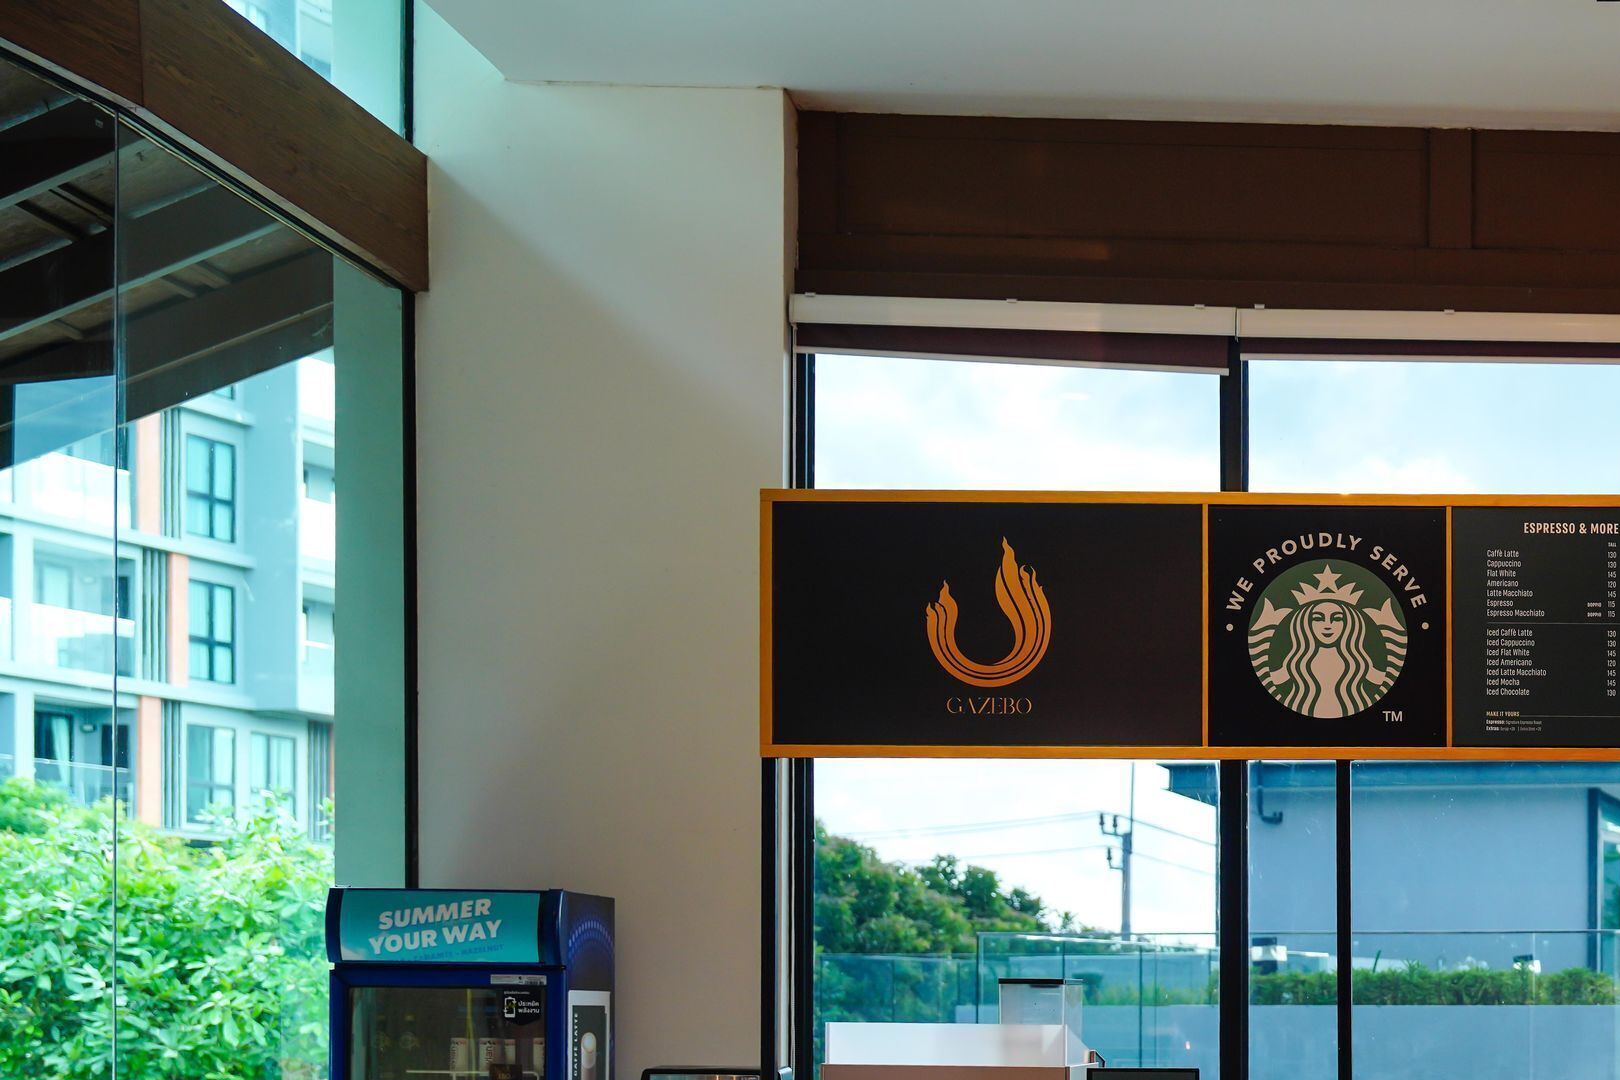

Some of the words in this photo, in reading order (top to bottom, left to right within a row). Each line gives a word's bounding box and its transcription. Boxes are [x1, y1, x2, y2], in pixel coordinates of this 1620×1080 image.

[1524, 523, 1575, 534] ESPRESSO
[1579, 523, 1587, 534] &
[1591, 523, 1619, 534] MORE
[1487, 550, 1502, 558] Caffè
[1504, 550, 1519, 558] Latte
[1487, 560, 1521, 568] Cappuccino
[1227, 576, 1253, 613] WE
[1253, 532, 1363, 574] PROUDLY
[1369, 544, 1428, 610] SERVE
[1487, 569, 1499, 577] Flat
[1500, 569, 1516, 577] White
[1607, 571, 1617, 579] 145
[1487, 579, 1519, 587] Americano
[1487, 609, 1513, 617] Espresso
[1515, 609, 1545, 617] Macchiato
[1487, 629, 1499, 637] Iced
[1501, 629, 1516, 637] Caffè
[1518, 629, 1533, 637] Latte
[1487, 639, 1499, 647] Iced
[1501, 639, 1535, 647] Cappuccino
[1607, 640, 1616, 648] 130
[1487, 649, 1499, 657] Iced
[1501, 649, 1512, 657] Flat
[1513, 649, 1529, 657] White
[1607, 650, 1616, 658] 145
[1487, 658, 1499, 666] Iced
[1501, 658, 1532, 666] Americano
[1486, 688, 1499, 696] Iced
[1501, 688, 1530, 696] Chocolate
[1607, 689, 1616, 697] 130
[946, 697, 1032, 715] GAZEBO
[1383, 710, 1403, 721] TM
[379, 898, 492, 930] SUMMER
[368, 930, 437, 955] YOUR
[442, 920, 502, 945] WAY
